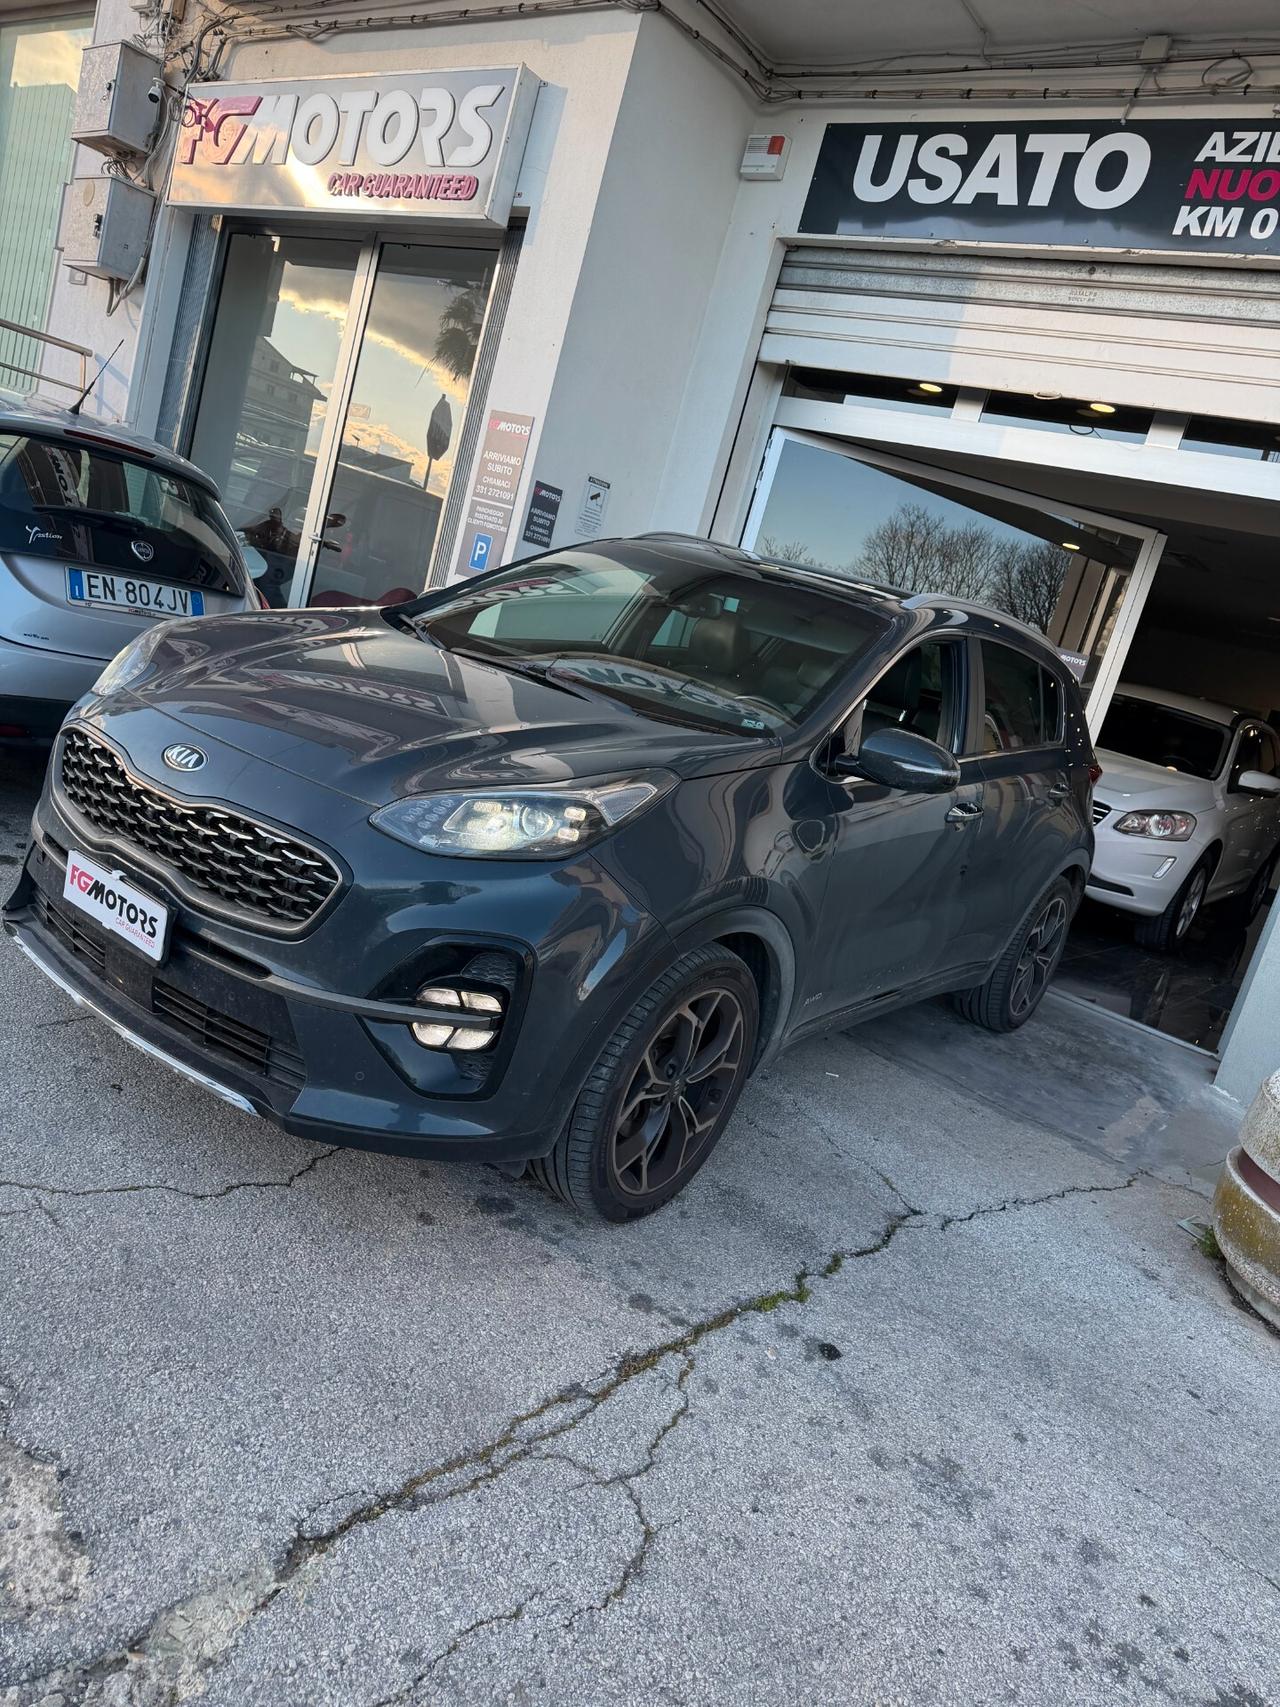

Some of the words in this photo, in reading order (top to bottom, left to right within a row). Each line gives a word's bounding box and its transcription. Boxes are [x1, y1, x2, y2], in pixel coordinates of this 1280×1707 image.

[852, 131, 1152, 210] USATO
[1184, 168, 1280, 201] NUO
[328, 173, 361, 197] CAR
[361, 173, 479, 201] GUARANTEED
[1172, 205, 1245, 238] KM
[1250, 207, 1279, 240] 0
[483, 451, 521, 466] ARRIVIAMO
[487, 463, 513, 476] SUBITO
[475, 485, 487, 495] 331
[487, 488, 514, 501] 2721091
[482, 476, 512, 489] CHIAMACI
[474, 541, 487, 561] P
[87, 574, 116, 601] EN
[125, 581, 188, 614] 804JV
[167, 745, 200, 768] KIA
[69, 863, 159, 939] FGMOTORS
[115, 917, 125, 927] CAR
[124, 922, 156, 949] GUARANTEED
